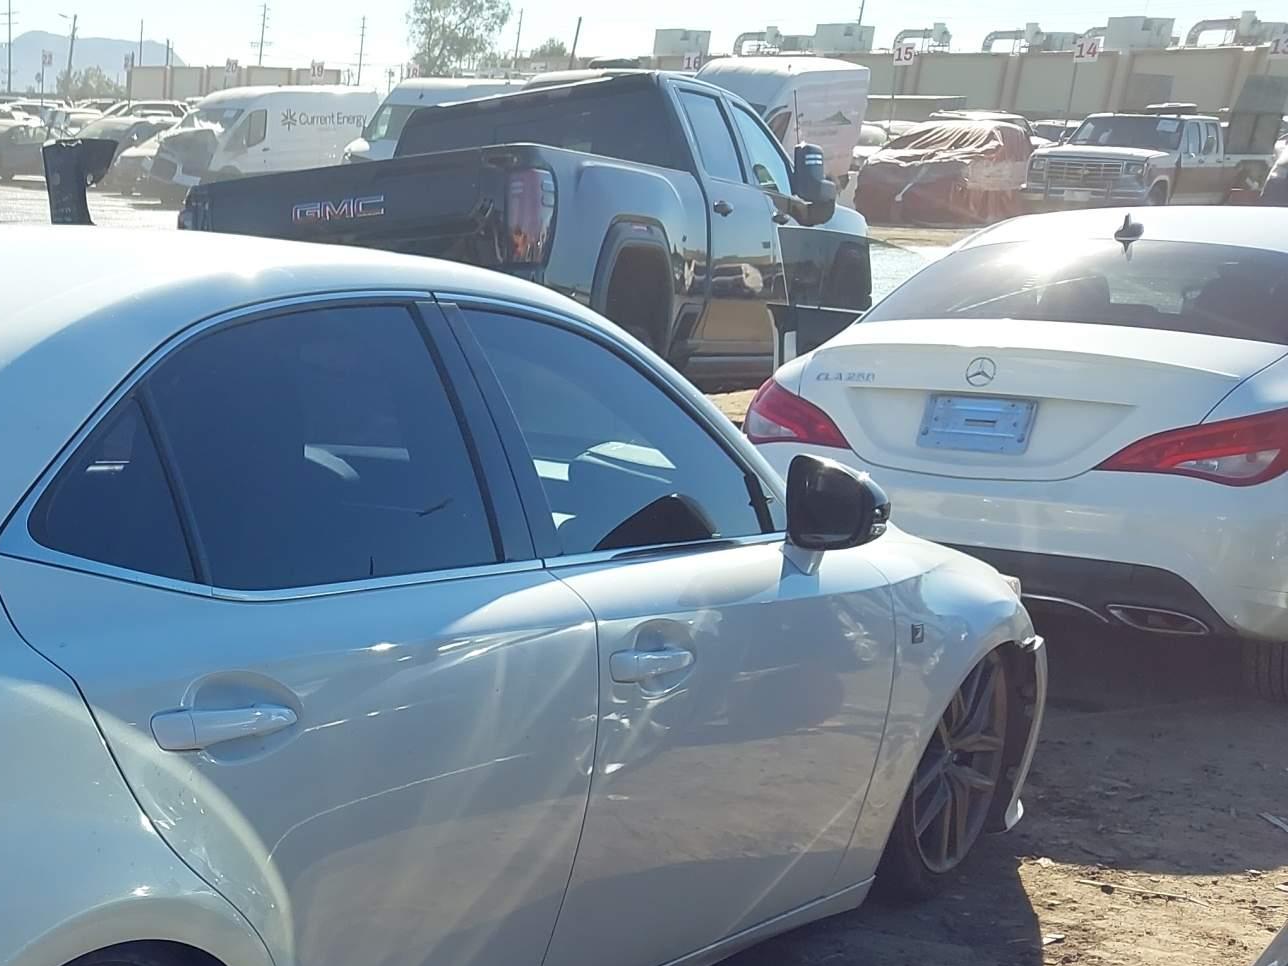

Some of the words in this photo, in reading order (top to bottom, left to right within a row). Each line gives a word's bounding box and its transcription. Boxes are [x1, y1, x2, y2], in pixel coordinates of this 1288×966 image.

[894, 46, 915, 62] 15
[1075, 42, 1097, 58] 14
[312, 65, 324, 77] 19
[299, 112, 334, 126] Current
[336, 112, 367, 128] Energy
[292, 194, 385, 222] GMC
[815, 371, 843, 382] CLA
[845, 372, 876, 383] 250
